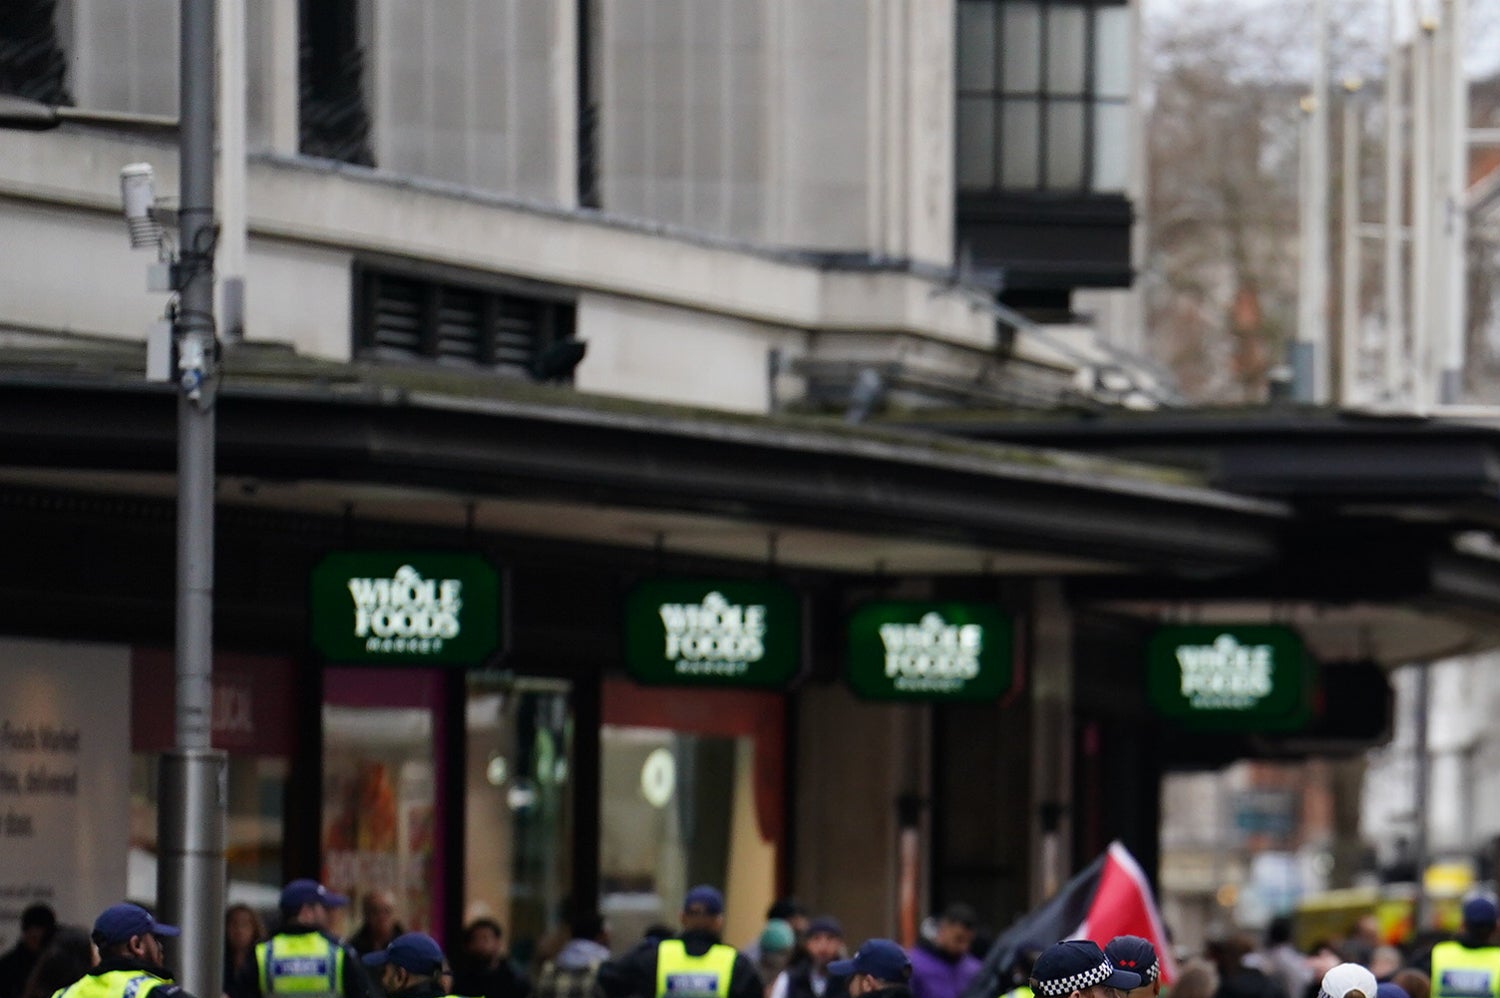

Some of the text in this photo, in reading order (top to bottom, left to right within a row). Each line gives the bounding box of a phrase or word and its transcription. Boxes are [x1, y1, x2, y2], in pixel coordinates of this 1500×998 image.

[348, 568, 462, 608] WHOLE
[355, 605, 460, 639] FOODS
[660, 595, 766, 635] WHOLE
[665, 633, 764, 661] FOODS
[879, 616, 983, 655] WHOLE
[885, 653, 980, 678] FOODS
[1175, 637, 1275, 675] WHOLE
[1181, 672, 1273, 697] FOODS
